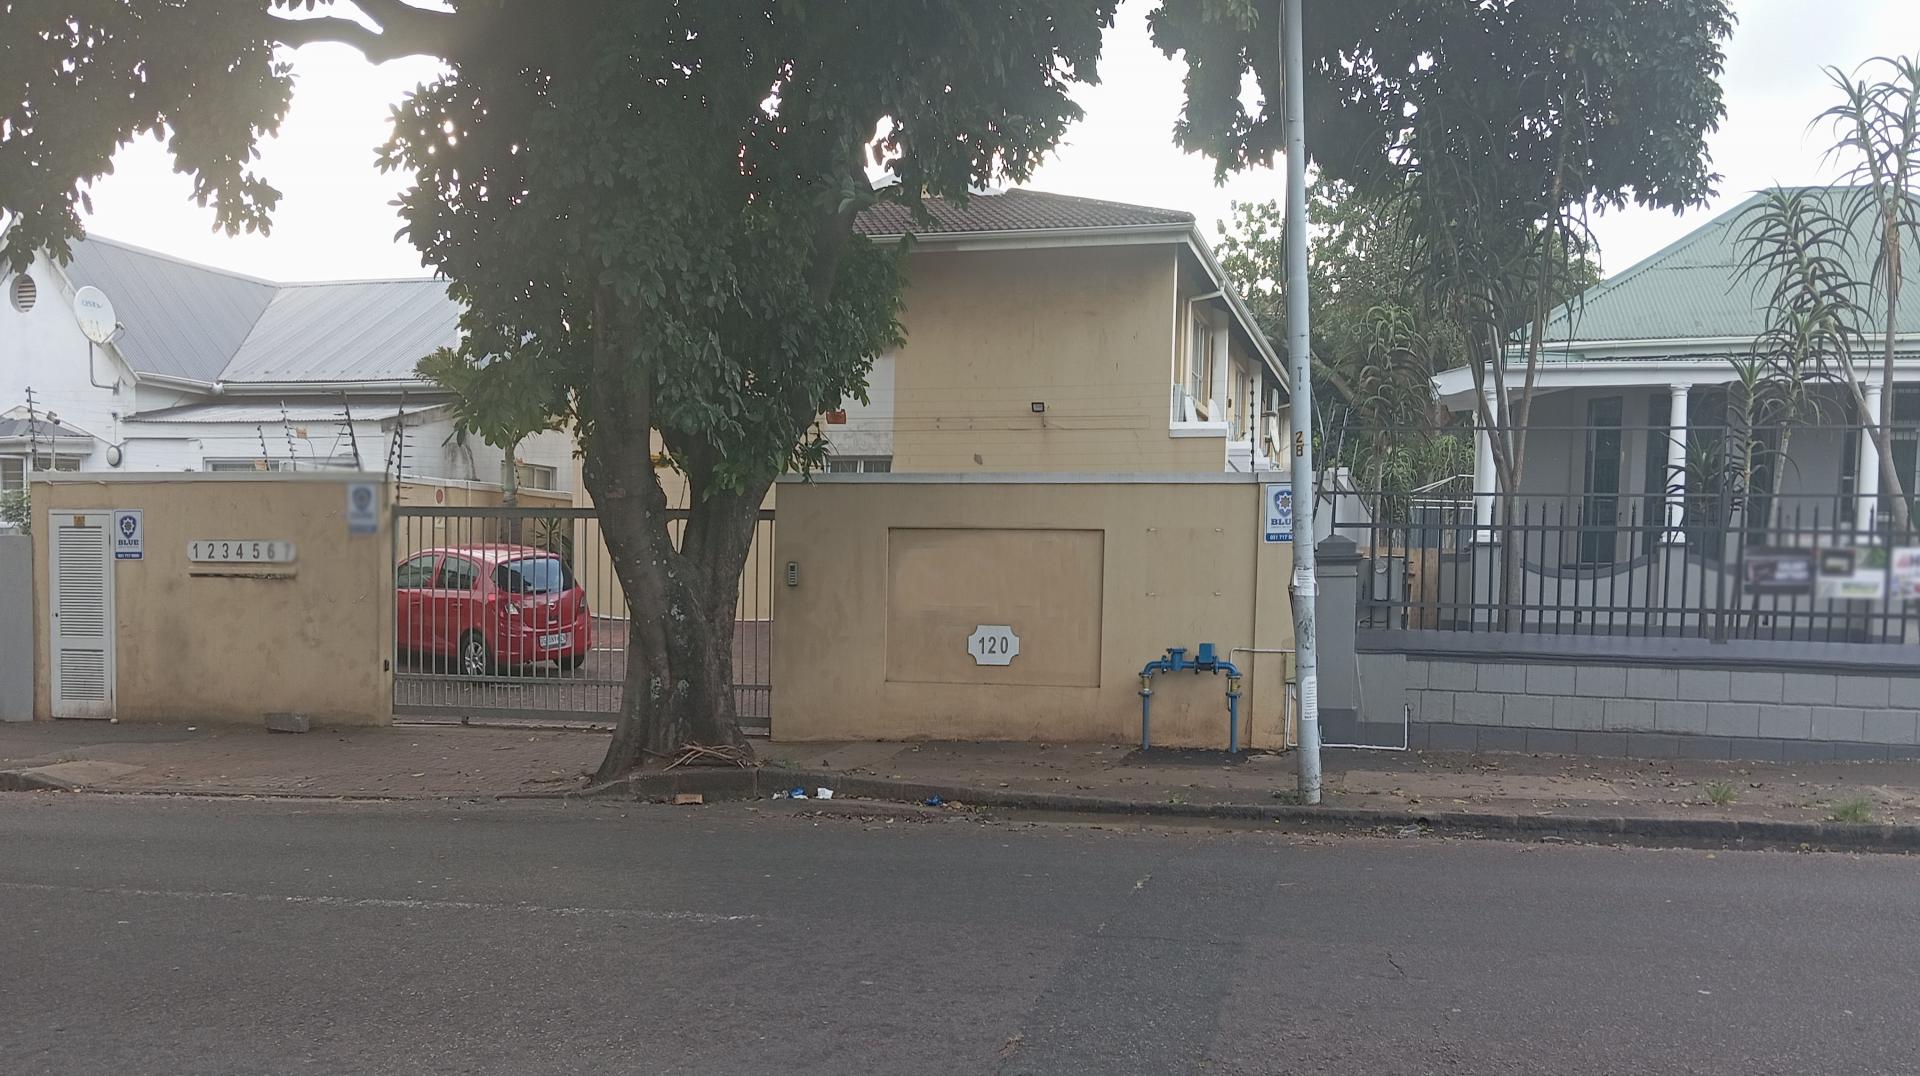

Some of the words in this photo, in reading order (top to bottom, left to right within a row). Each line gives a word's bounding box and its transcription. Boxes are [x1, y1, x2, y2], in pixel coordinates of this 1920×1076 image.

[1271, 518, 1292, 526] BLU
[208, 543, 215, 559] 2
[222, 543, 229, 559] 3
[236, 543, 243, 559] 4
[253, 543, 260, 559] 5
[978, 636, 1009, 654] 120
